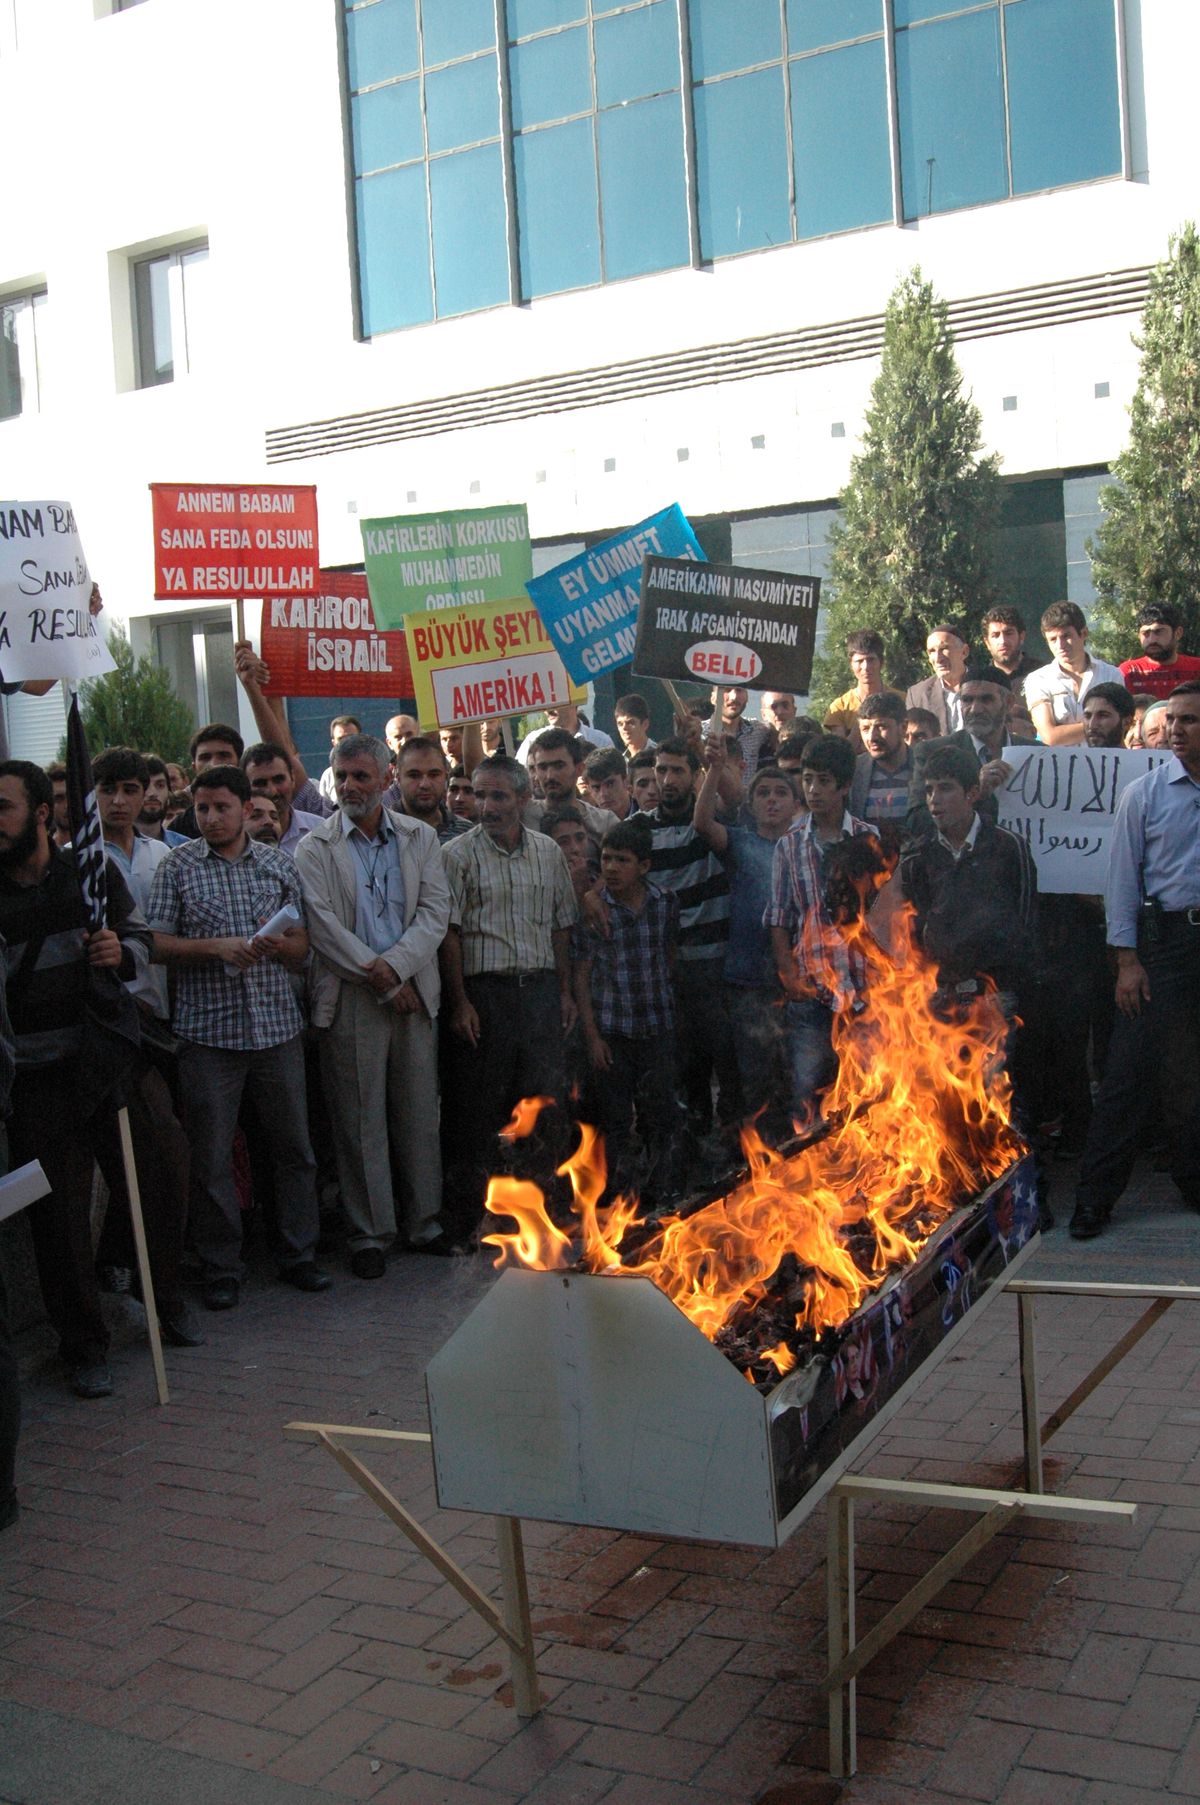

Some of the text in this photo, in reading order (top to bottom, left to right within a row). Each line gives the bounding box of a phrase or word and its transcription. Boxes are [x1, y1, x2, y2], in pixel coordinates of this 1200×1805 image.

[177, 492, 295, 513] ANNEM BABAM
[161, 528, 313, 549] SANA FEDA OLSUN!
[366, 516, 527, 556] KAFİRLERİN KORKUSU
[162, 567, 313, 591] YA RESULULLAH
[401, 548, 502, 587] MUHAMMEDİN
[558, 526, 663, 601] EY ÜMMET
[648, 567, 814, 609] AMERİKANIN MASUMİYETİ
[271, 596, 375, 631] KAHROL
[554, 584, 641, 645] UYANMA
[656, 607, 799, 646] IRAK AFGANİSTANDAN
[308, 632, 392, 673] İSRAİL
[413, 610, 550, 662] BÜYÜK ŞEYT
[692, 652, 756, 678] BELLİ
[453, 669, 545, 720] AMERİKA
